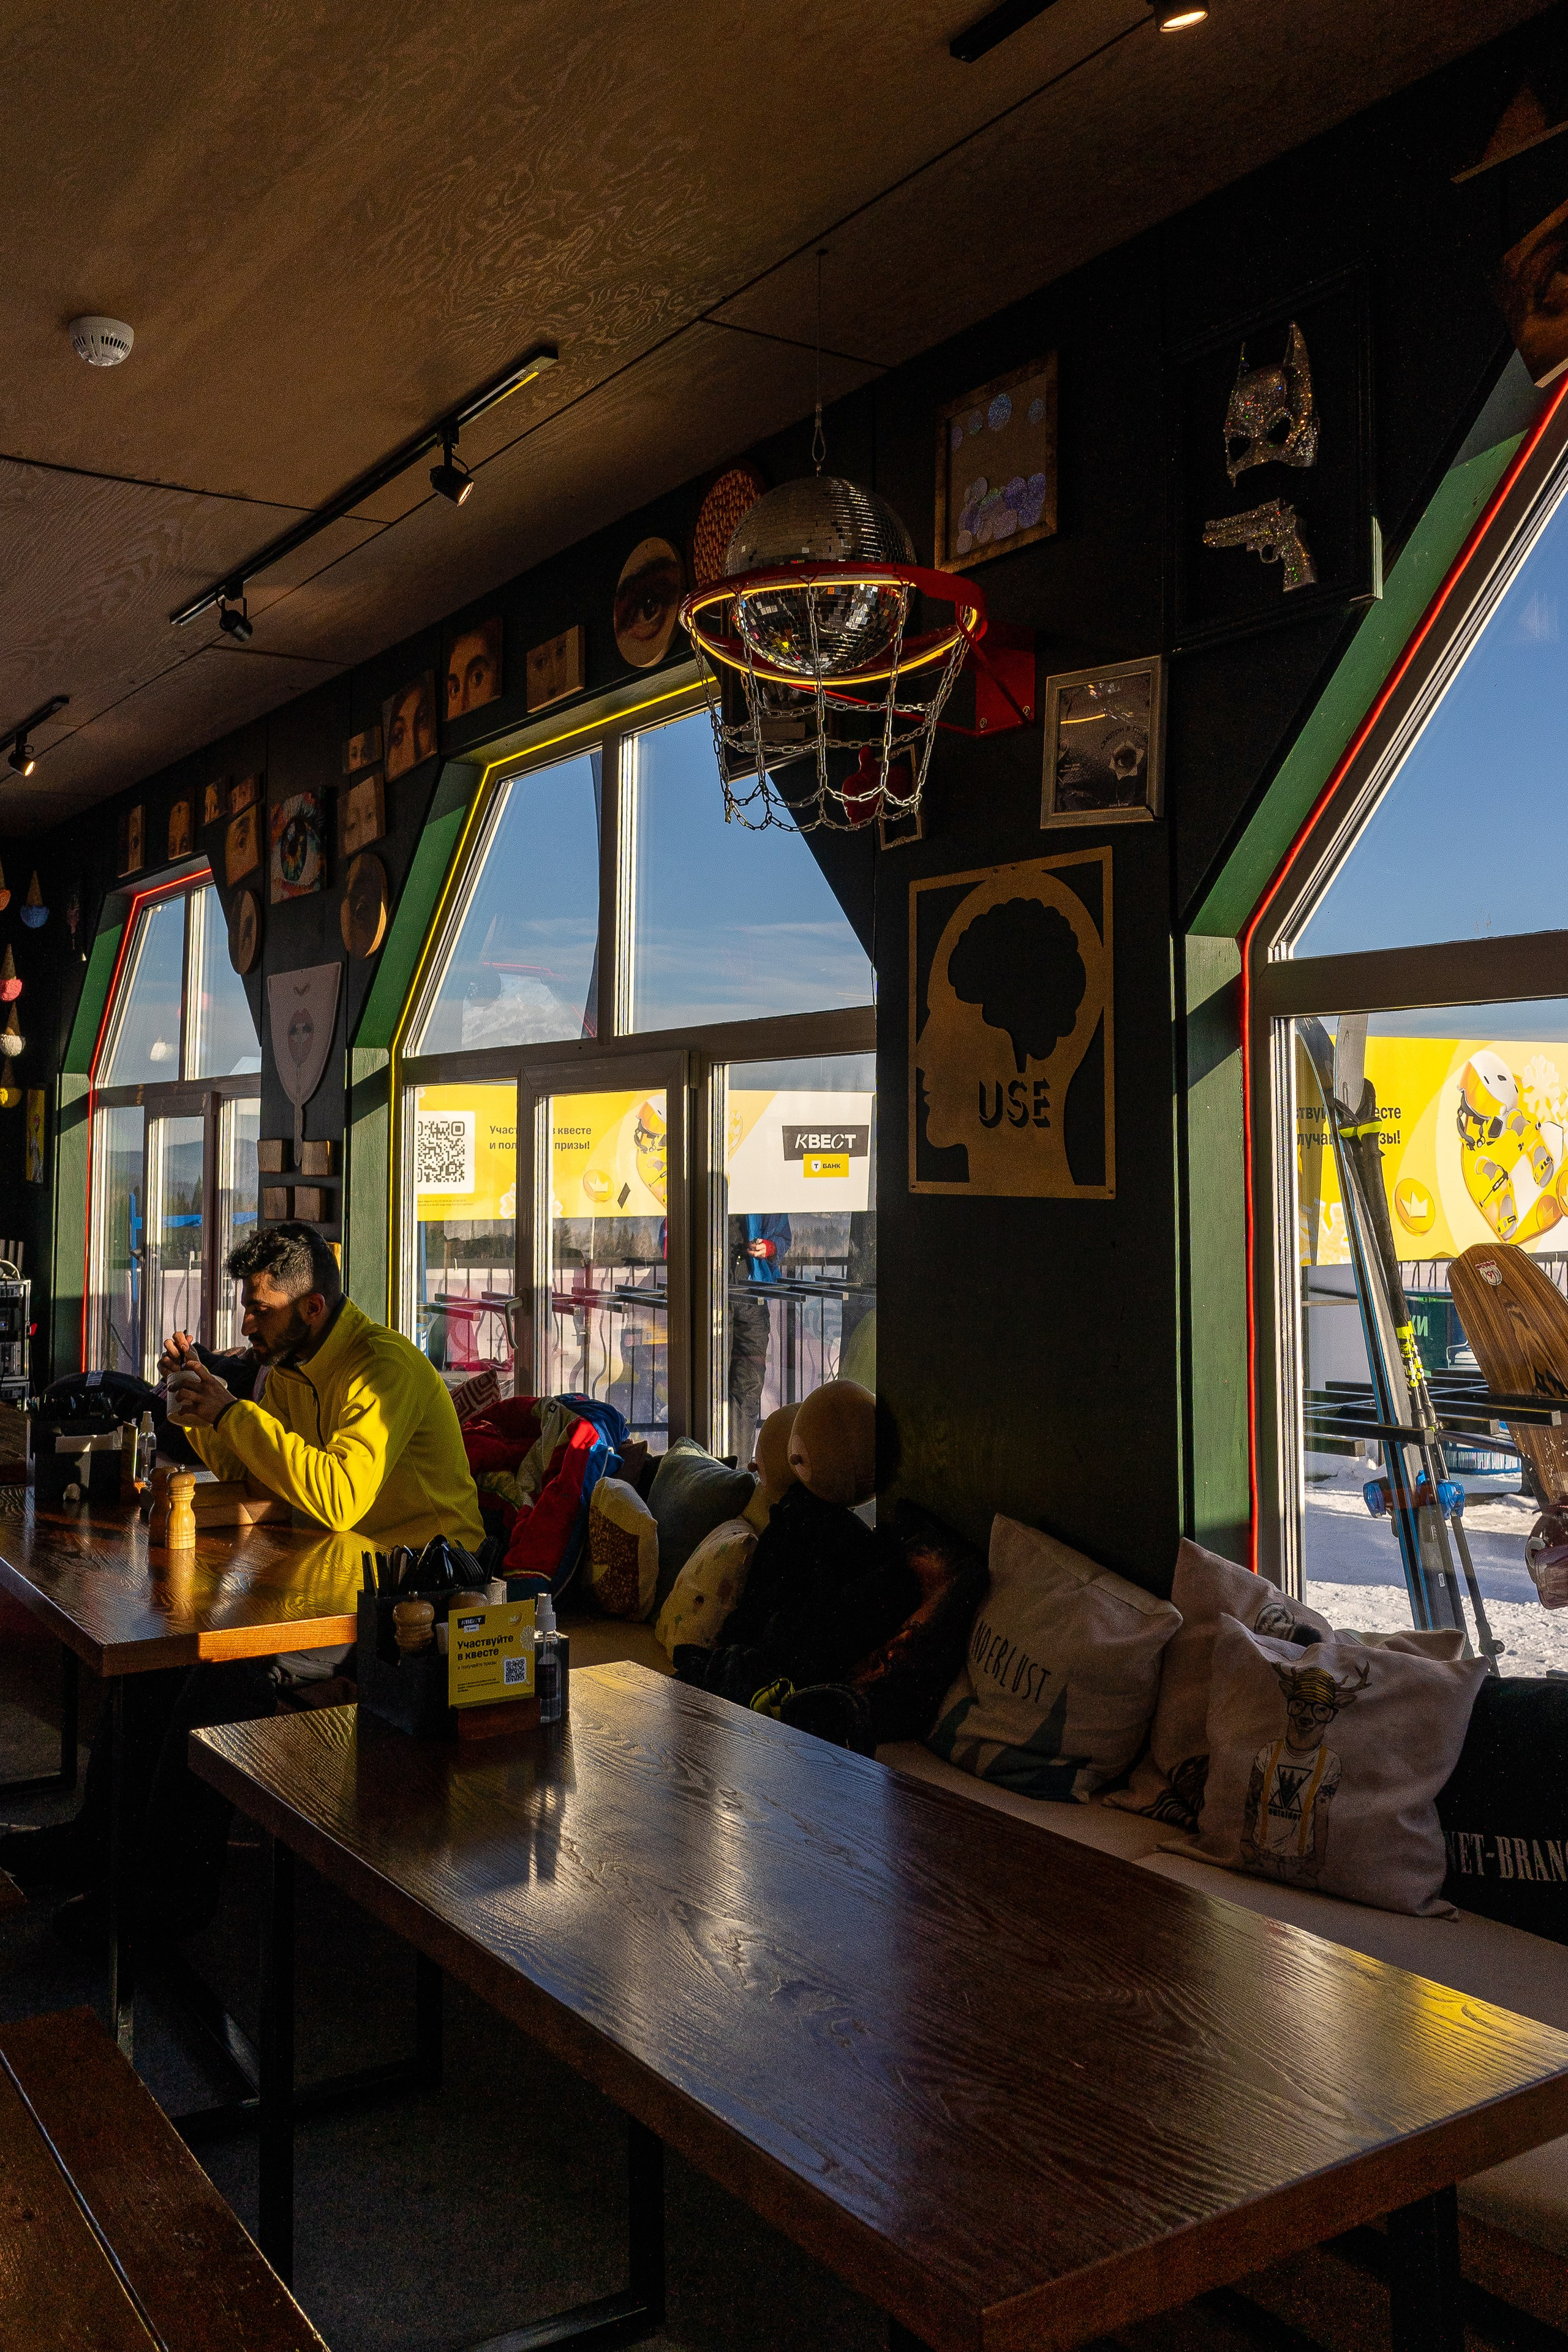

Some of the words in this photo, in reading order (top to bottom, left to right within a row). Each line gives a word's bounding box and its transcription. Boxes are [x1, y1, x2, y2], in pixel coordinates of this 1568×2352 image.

[979, 1077, 1051, 1128] USE
[489, 1125, 516, 1134] Учас
[555, 1140, 590, 1152] призы!
[794, 1133, 856, 1149] КВЕСТ
[461, 1617, 481, 1626] КВЕСТ
[457, 1635, 514, 1650] Участвуйте
[465, 1648, 499, 1660] квесте
[967, 1619, 1051, 1703] NDERLUST
[1444, 1830, 1567, 1882] NET-BRAN
